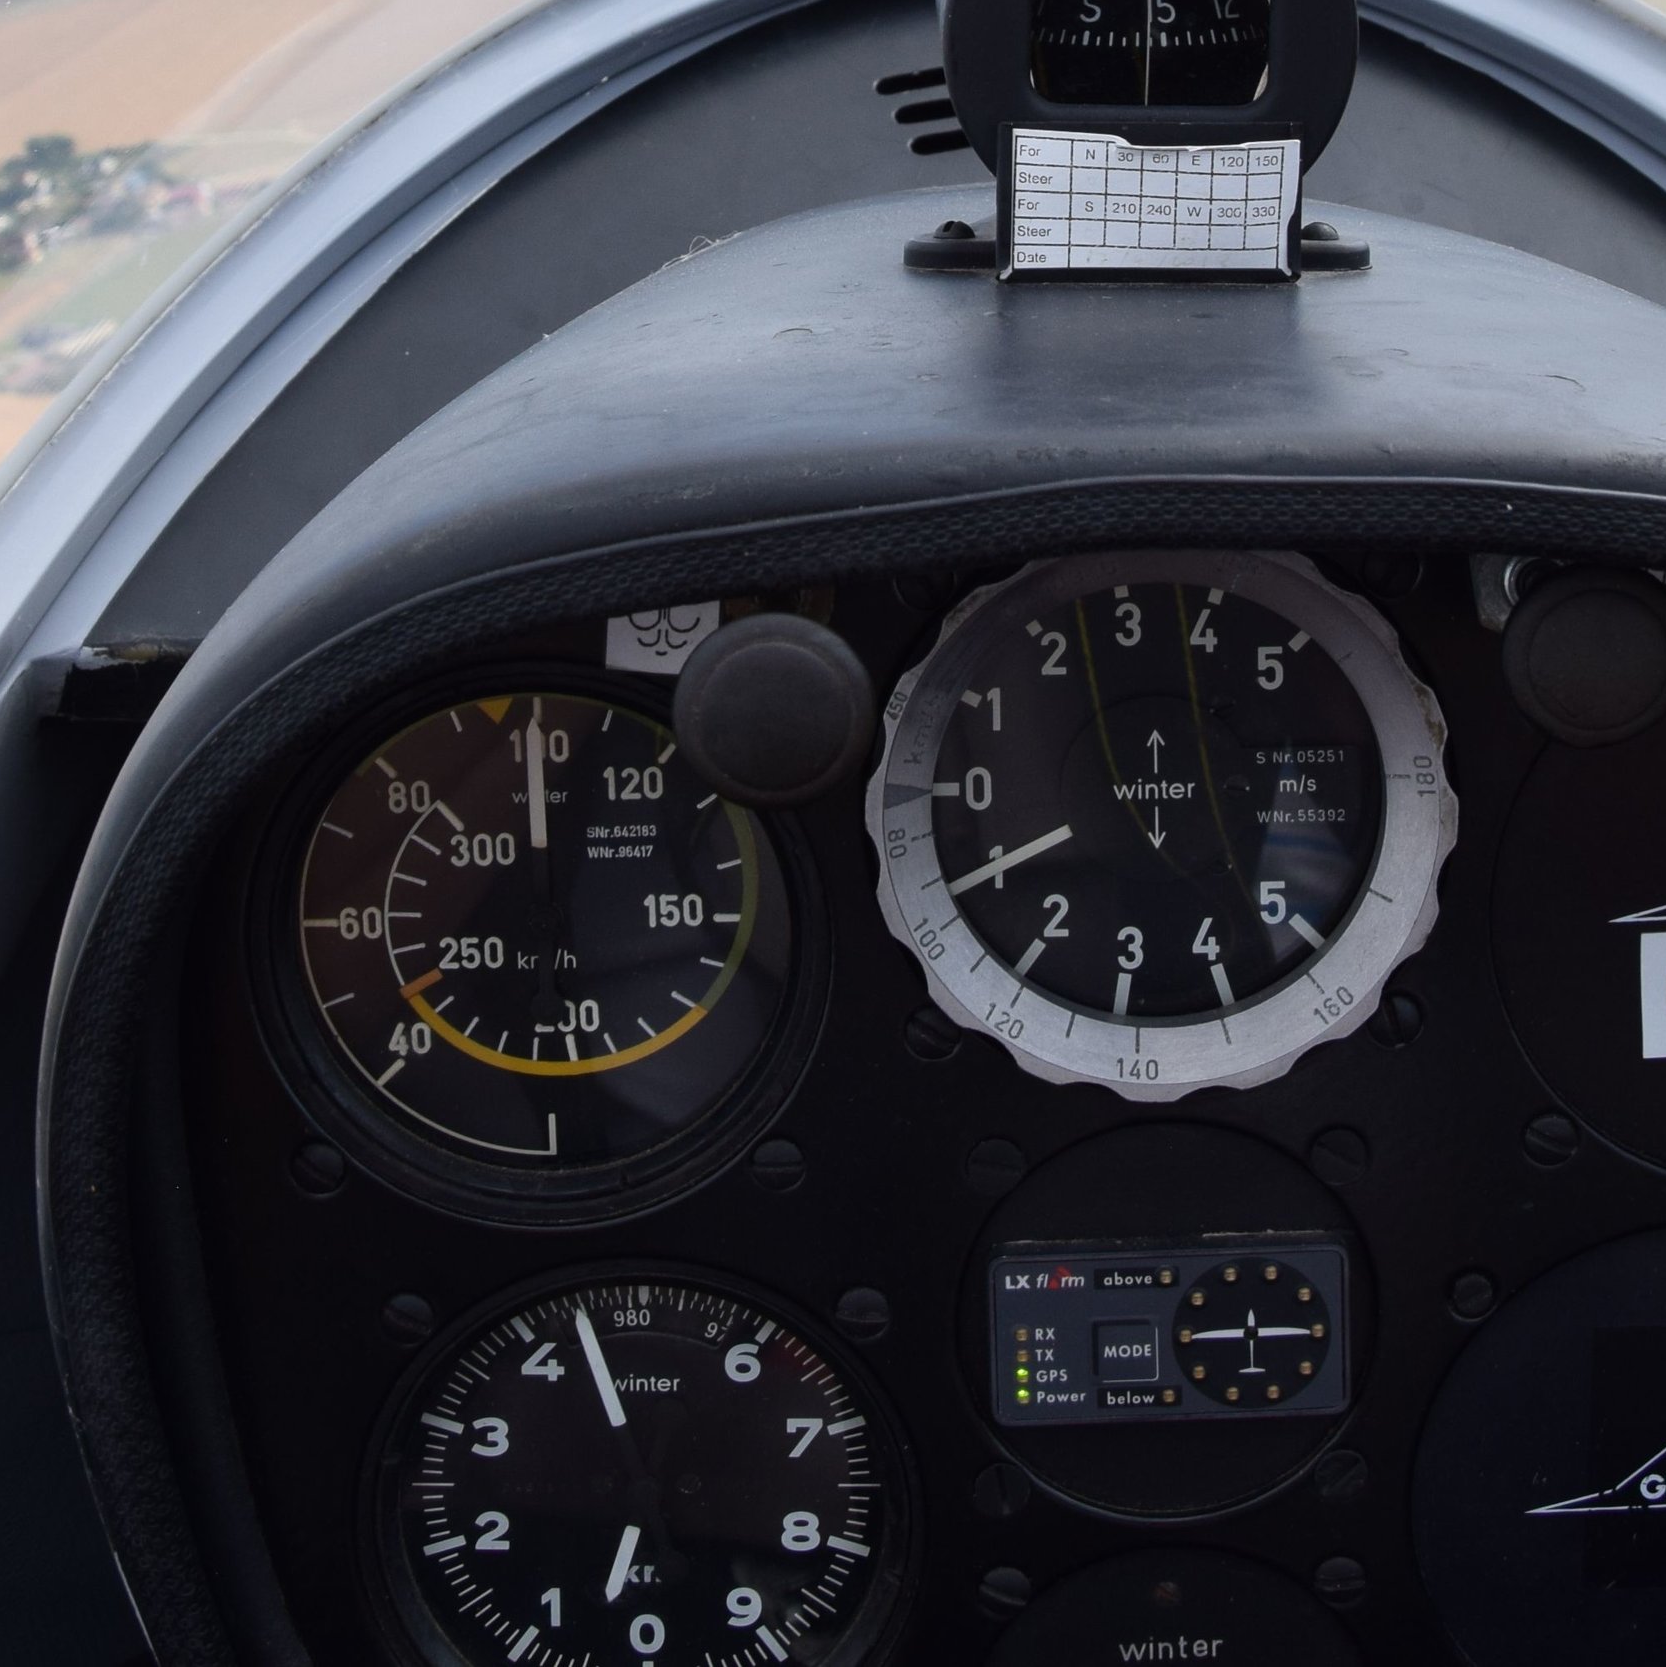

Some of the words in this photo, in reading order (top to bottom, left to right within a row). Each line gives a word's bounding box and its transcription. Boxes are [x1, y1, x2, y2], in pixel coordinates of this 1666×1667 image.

[1019, 144, 1041, 158] For
[1085, 149, 1096, 161] N
[1117, 151, 1134, 163] 30
[1192, 155, 1201, 166] E
[1220, 156, 1244, 168] 120
[1255, 155, 1279, 167] 150
[1018, 171, 1053, 184] Steer
[1017, 198, 1040, 211] For
[1085, 201, 1094, 213] S
[1112, 202, 1137, 215] 210
[1146, 203, 1172, 216] 240
[1186, 205, 1202, 218] W
[1216, 206, 1242, 218] 300
[1252, 205, 1276, 218] 330
[1016, 225, 1052, 238] Steer
[1016, 251, 1047, 264] Date
[1114, 604, 1143, 646] 3
[1189, 609, 1218, 653] 4
[1040, 631, 1068, 676] 2
[1257, 646, 1285, 690] 5
[985, 688, 1002, 732] 1
[509, 728, 570, 764] 10
[602, 765, 664, 801] 120
[964, 767, 993, 810] 0
[1113, 776, 1196, 802] winter
[1279, 774, 1317, 795] m/s
[1413, 755, 1437, 797] 180
[387, 780, 431, 813] 80
[449, 833, 516, 867] 300
[887, 827, 907, 860] 80
[987, 844, 1006, 889] 1
[643, 893, 704, 928] 150
[1042, 894, 1070, 938] 2
[1258, 881, 1287, 925] 5
[339, 906, 382, 940] 60
[912, 916, 946, 961] 100
[1191, 918, 1221, 961] 4
[438, 937, 504, 971] 250
[1116, 926, 1145, 970] 3
[984, 1001, 1024, 1040] 120
[1312, 985, 1356, 1027] 160
[387, 1021, 432, 1055] 40
[1115, 1056, 1159, 1082] 140
[1004, 1275, 1031, 1291] LX
[1103, 1271, 1153, 1287] above
[613, 1308, 651, 1328] 980
[1035, 1327, 1056, 1342] RX
[520, 1342, 566, 1382] 4
[723, 1343, 762, 1383] 6
[1035, 1348, 1055, 1362] TX
[1103, 1342, 1152, 1359] MODE
[1035, 1369, 1068, 1383] GPS
[1036, 1389, 1086, 1404] Power
[1106, 1390, 1156, 1407] below
[470, 1416, 510, 1457] 3
[785, 1417, 824, 1458] 7
[474, 1511, 510, 1551] 2
[780, 1511, 821, 1552] 8
[540, 1587, 563, 1628] 1
[725, 1587, 764, 1627] 9
[628, 1613, 666, 1654] 0
[1118, 1635, 1224, 1663] winter
